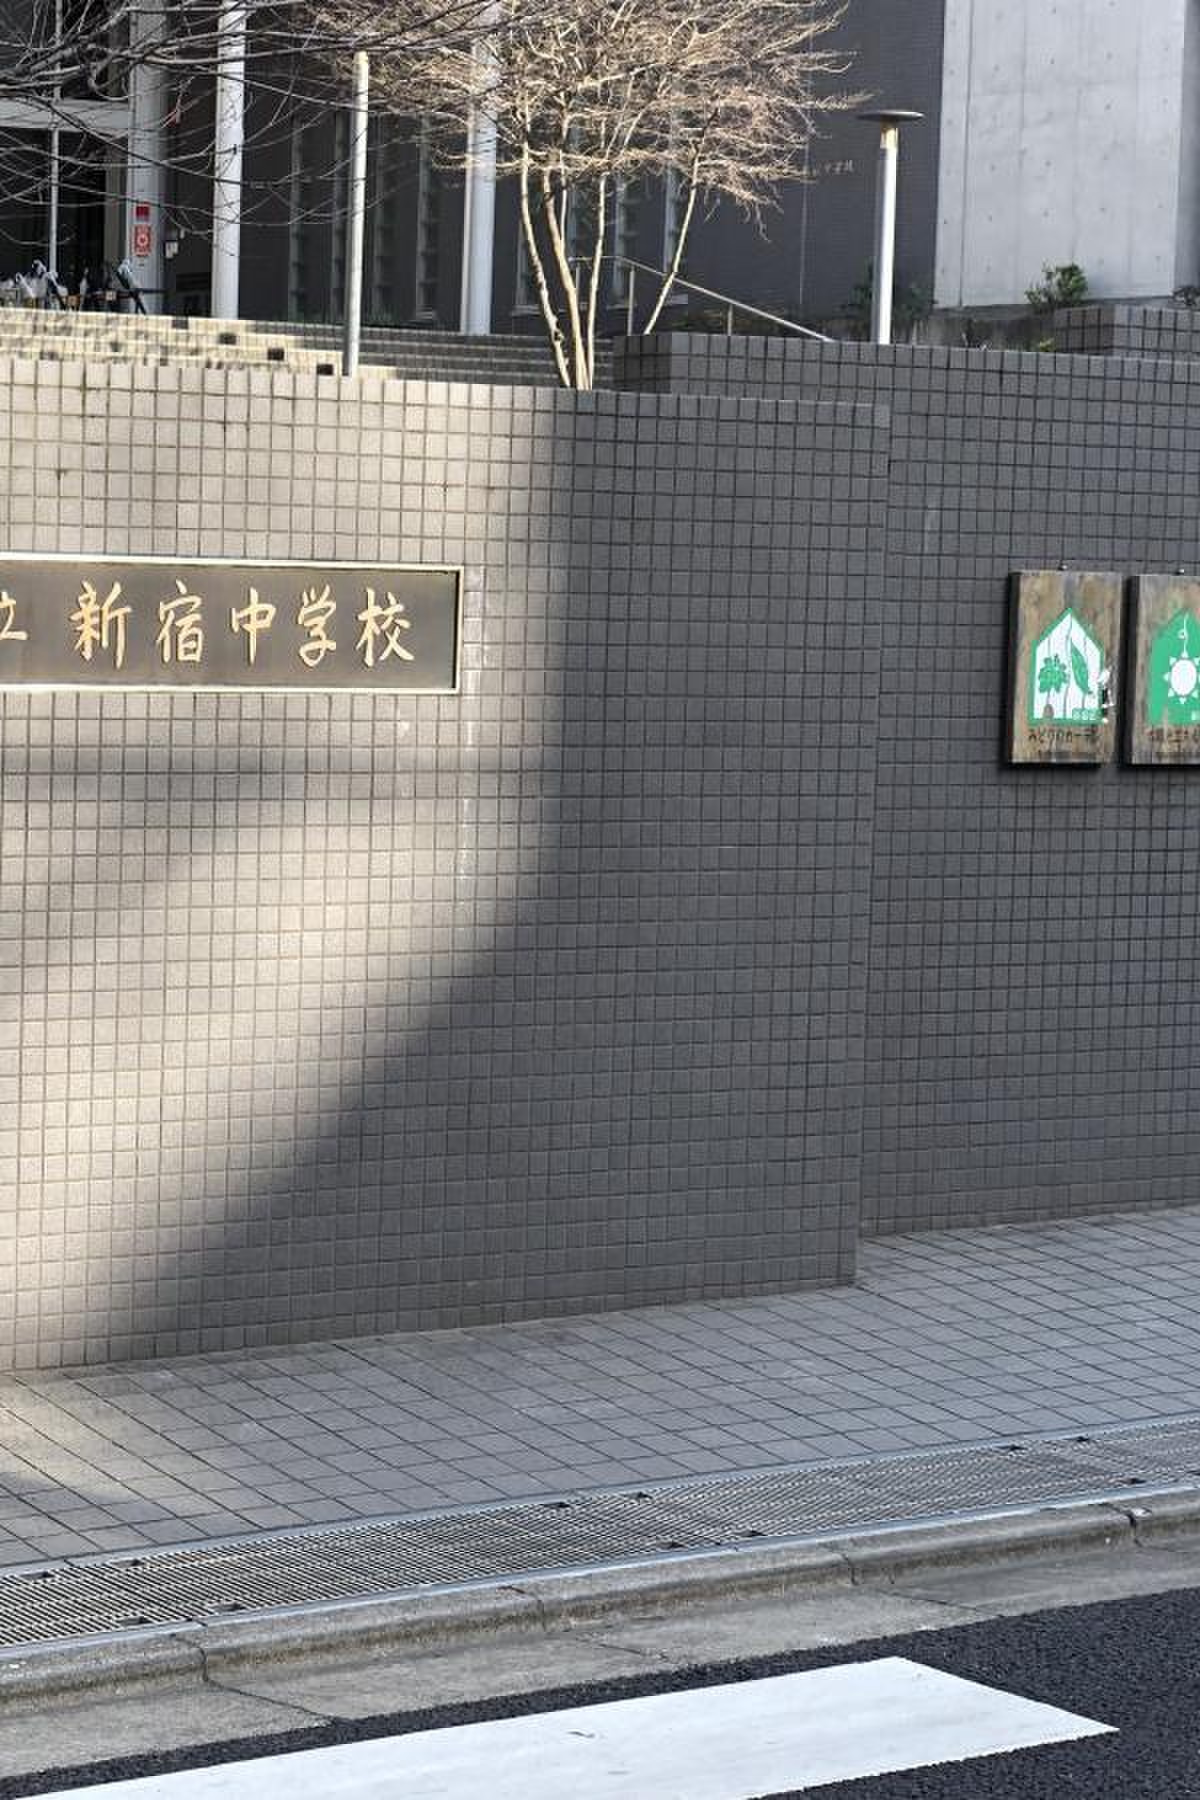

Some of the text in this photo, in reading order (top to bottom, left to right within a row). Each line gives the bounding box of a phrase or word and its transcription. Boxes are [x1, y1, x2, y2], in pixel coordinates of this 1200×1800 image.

[69, 579, 416, 669] 新宿中学校
